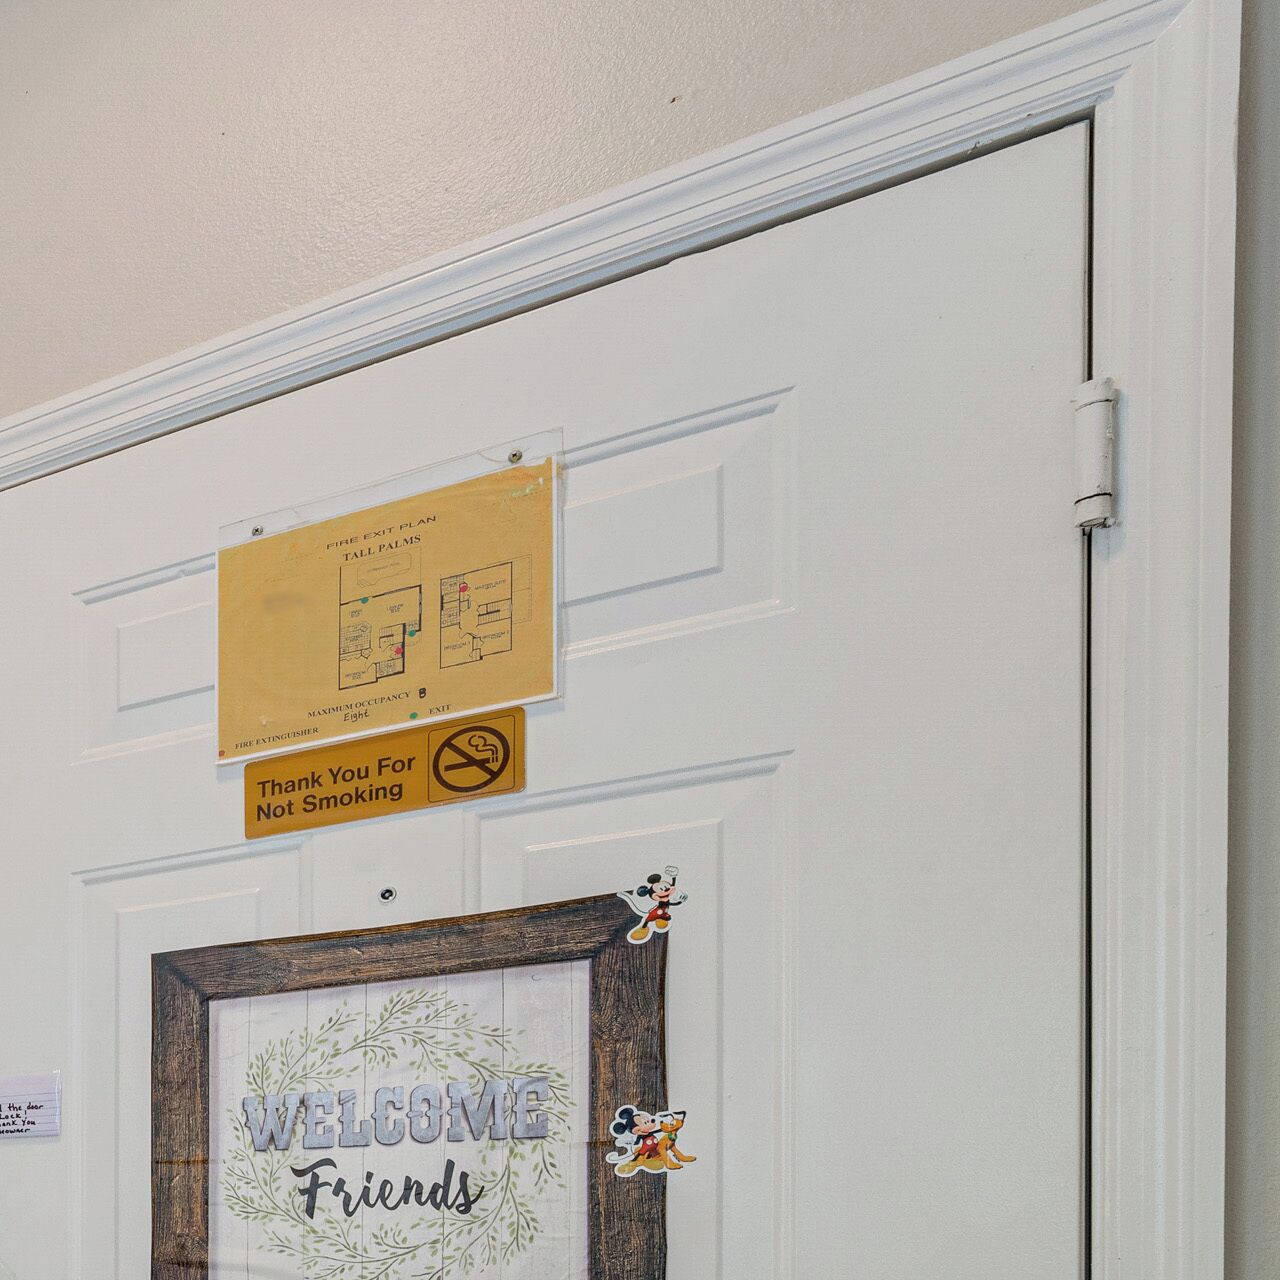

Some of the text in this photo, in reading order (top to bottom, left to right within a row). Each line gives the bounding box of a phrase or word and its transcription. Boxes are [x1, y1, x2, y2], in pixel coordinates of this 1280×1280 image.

[327, 515, 436, 550] FIRE EXIT PLAN
[343, 534, 421, 561] TALL PALMS
[308, 692, 409, 718] MAXIMUM OCCUPANCY
[343, 708, 369, 723] Eight
[429, 704, 449, 715] EXIT
[235, 727, 318, 749] FIRE EXTINGUISHER
[257, 756, 416, 798] Thank You For
[257, 783, 403, 822] Not Smoking
[7, 1103, 22, 1111] the
[26, 1102, 44, 1110] door
[241, 1076, 549, 1152] WELCOME
[21, 1118, 36, 1126] You
[290, 1157, 486, 1219] Friends
